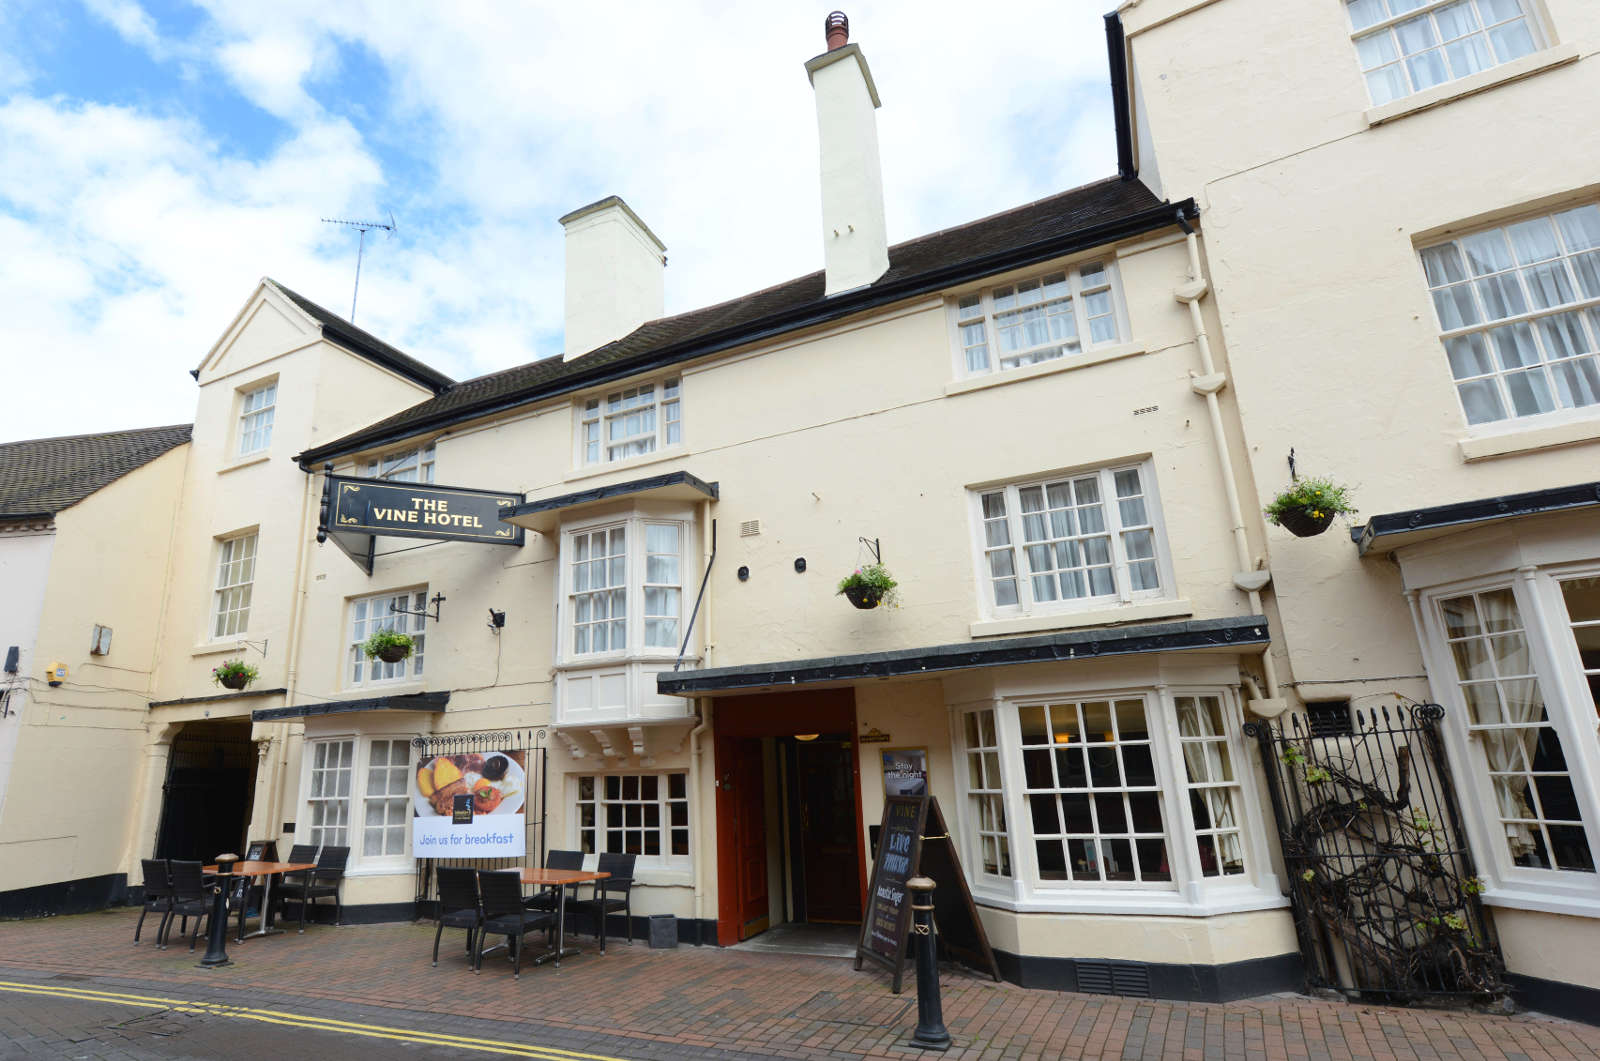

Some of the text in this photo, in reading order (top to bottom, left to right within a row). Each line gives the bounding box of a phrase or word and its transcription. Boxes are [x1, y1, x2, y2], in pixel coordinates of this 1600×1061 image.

[411, 497, 448, 512] THE
[373, 507, 483, 528] VINE HOTEL
[895, 761, 913, 771] Stay
[887, 769, 922, 781] the night
[419, 832, 514, 845] Join us for breakfast
